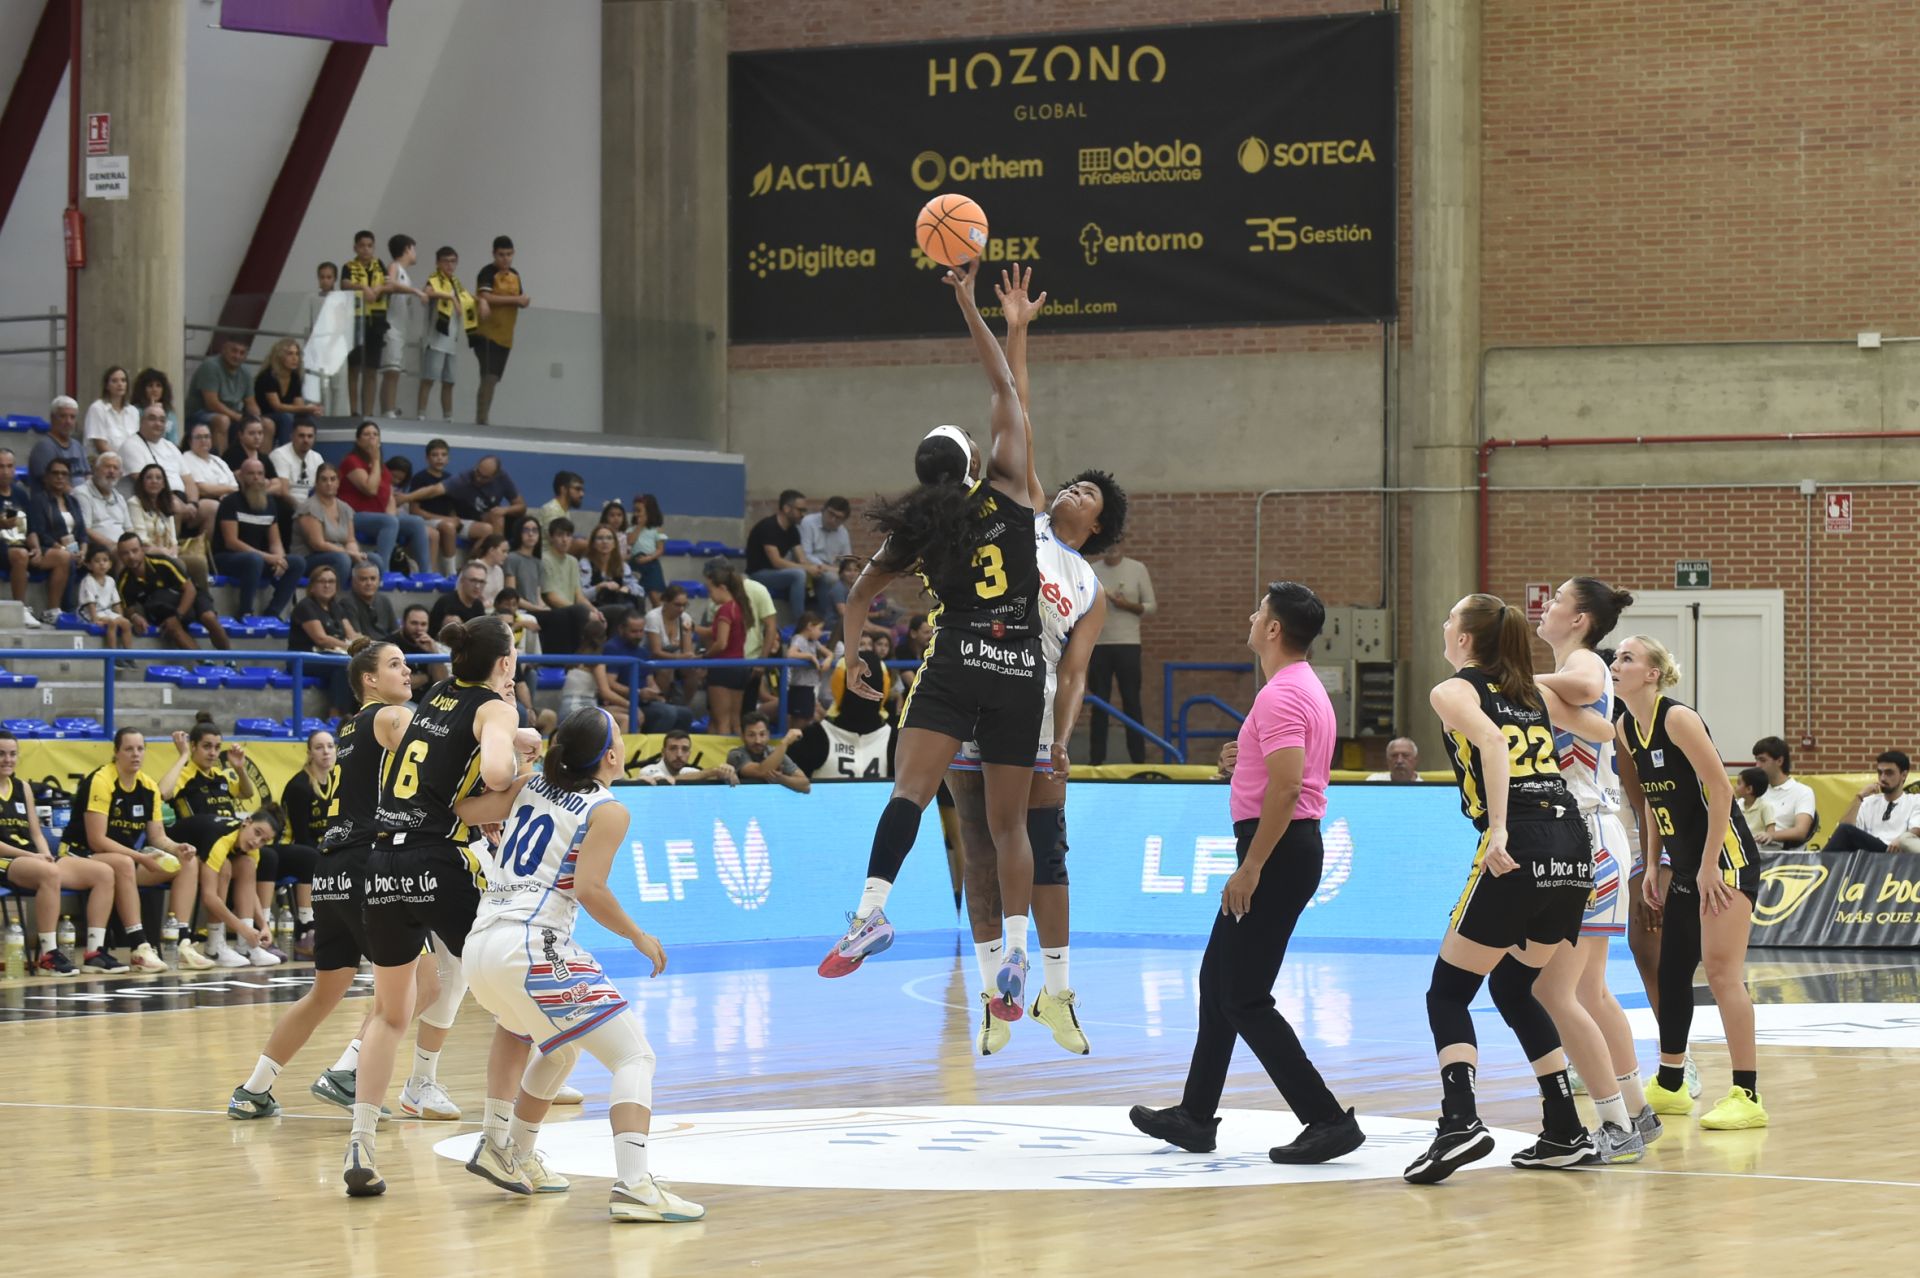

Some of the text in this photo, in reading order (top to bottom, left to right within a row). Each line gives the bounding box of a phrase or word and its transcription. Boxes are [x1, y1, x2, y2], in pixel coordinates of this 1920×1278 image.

[929, 45, 1166, 96] HOZONO
[1014, 102, 1087, 121] GLOBAL
[1113, 139, 1203, 171] abala
[1273, 139, 1376, 167] SOTECA
[88, 172, 127, 181] GENERAL
[776, 156, 873, 191] ACTÚA
[950, 154, 1044, 181] Orthem
[1079, 167, 1203, 186] infraestructuras
[96, 182, 121, 191] IMPAR
[1103, 231, 1204, 253] entorno
[1300, 224, 1373, 244] Gestión
[780, 246, 876, 277] Digiltea
[972, 543, 1008, 599] 3
[1677, 562, 1709, 571] SALIDA
[960, 640, 974, 656] la
[1003, 650, 1018, 665] te
[963, 658, 981, 667] MÁS
[981, 661, 997, 671] QUE
[835, 743, 855, 755] IRIS
[1500, 724, 1561, 777] 22
[393, 739, 429, 799] 6
[838, 757, 880, 778] 54
[1652, 807, 1675, 836] 13
[500, 804, 555, 877] 10
[631, 839, 699, 902] LF
[1141, 835, 1239, 894] LF
[1532, 860, 1546, 878] la
[1550, 857, 1574, 876] boca
[1576, 861, 1589, 878] te
[337, 871, 352, 891] lía
[400, 876, 414, 893] te
[418, 870, 438, 892] lía
[1536, 879, 1552, 888] MÁS
[1838, 876, 1866, 904] la
[380, 895, 396, 904] QUE
[1836, 910, 1912, 925] MÁS QUE
